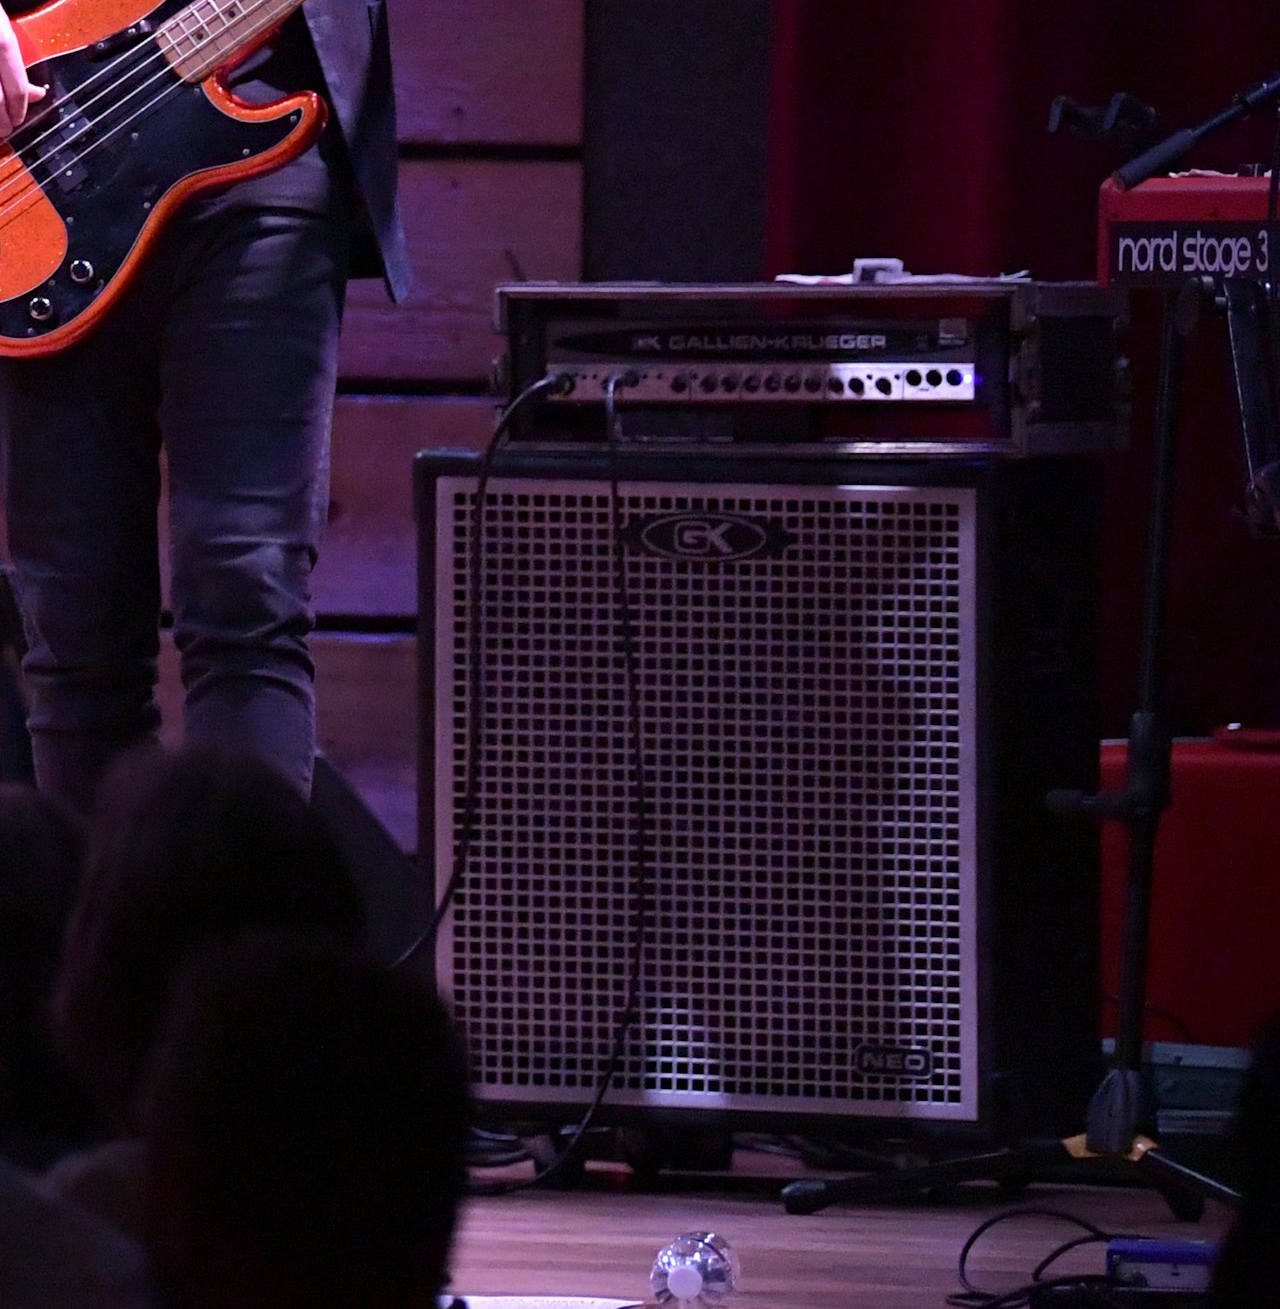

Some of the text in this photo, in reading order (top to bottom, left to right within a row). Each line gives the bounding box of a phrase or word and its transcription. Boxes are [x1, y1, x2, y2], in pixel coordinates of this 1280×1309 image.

[1118, 230, 1269, 278] nord stage 3
[673, 520, 734, 554] GK
[862, 1051, 926, 1071] NEO
